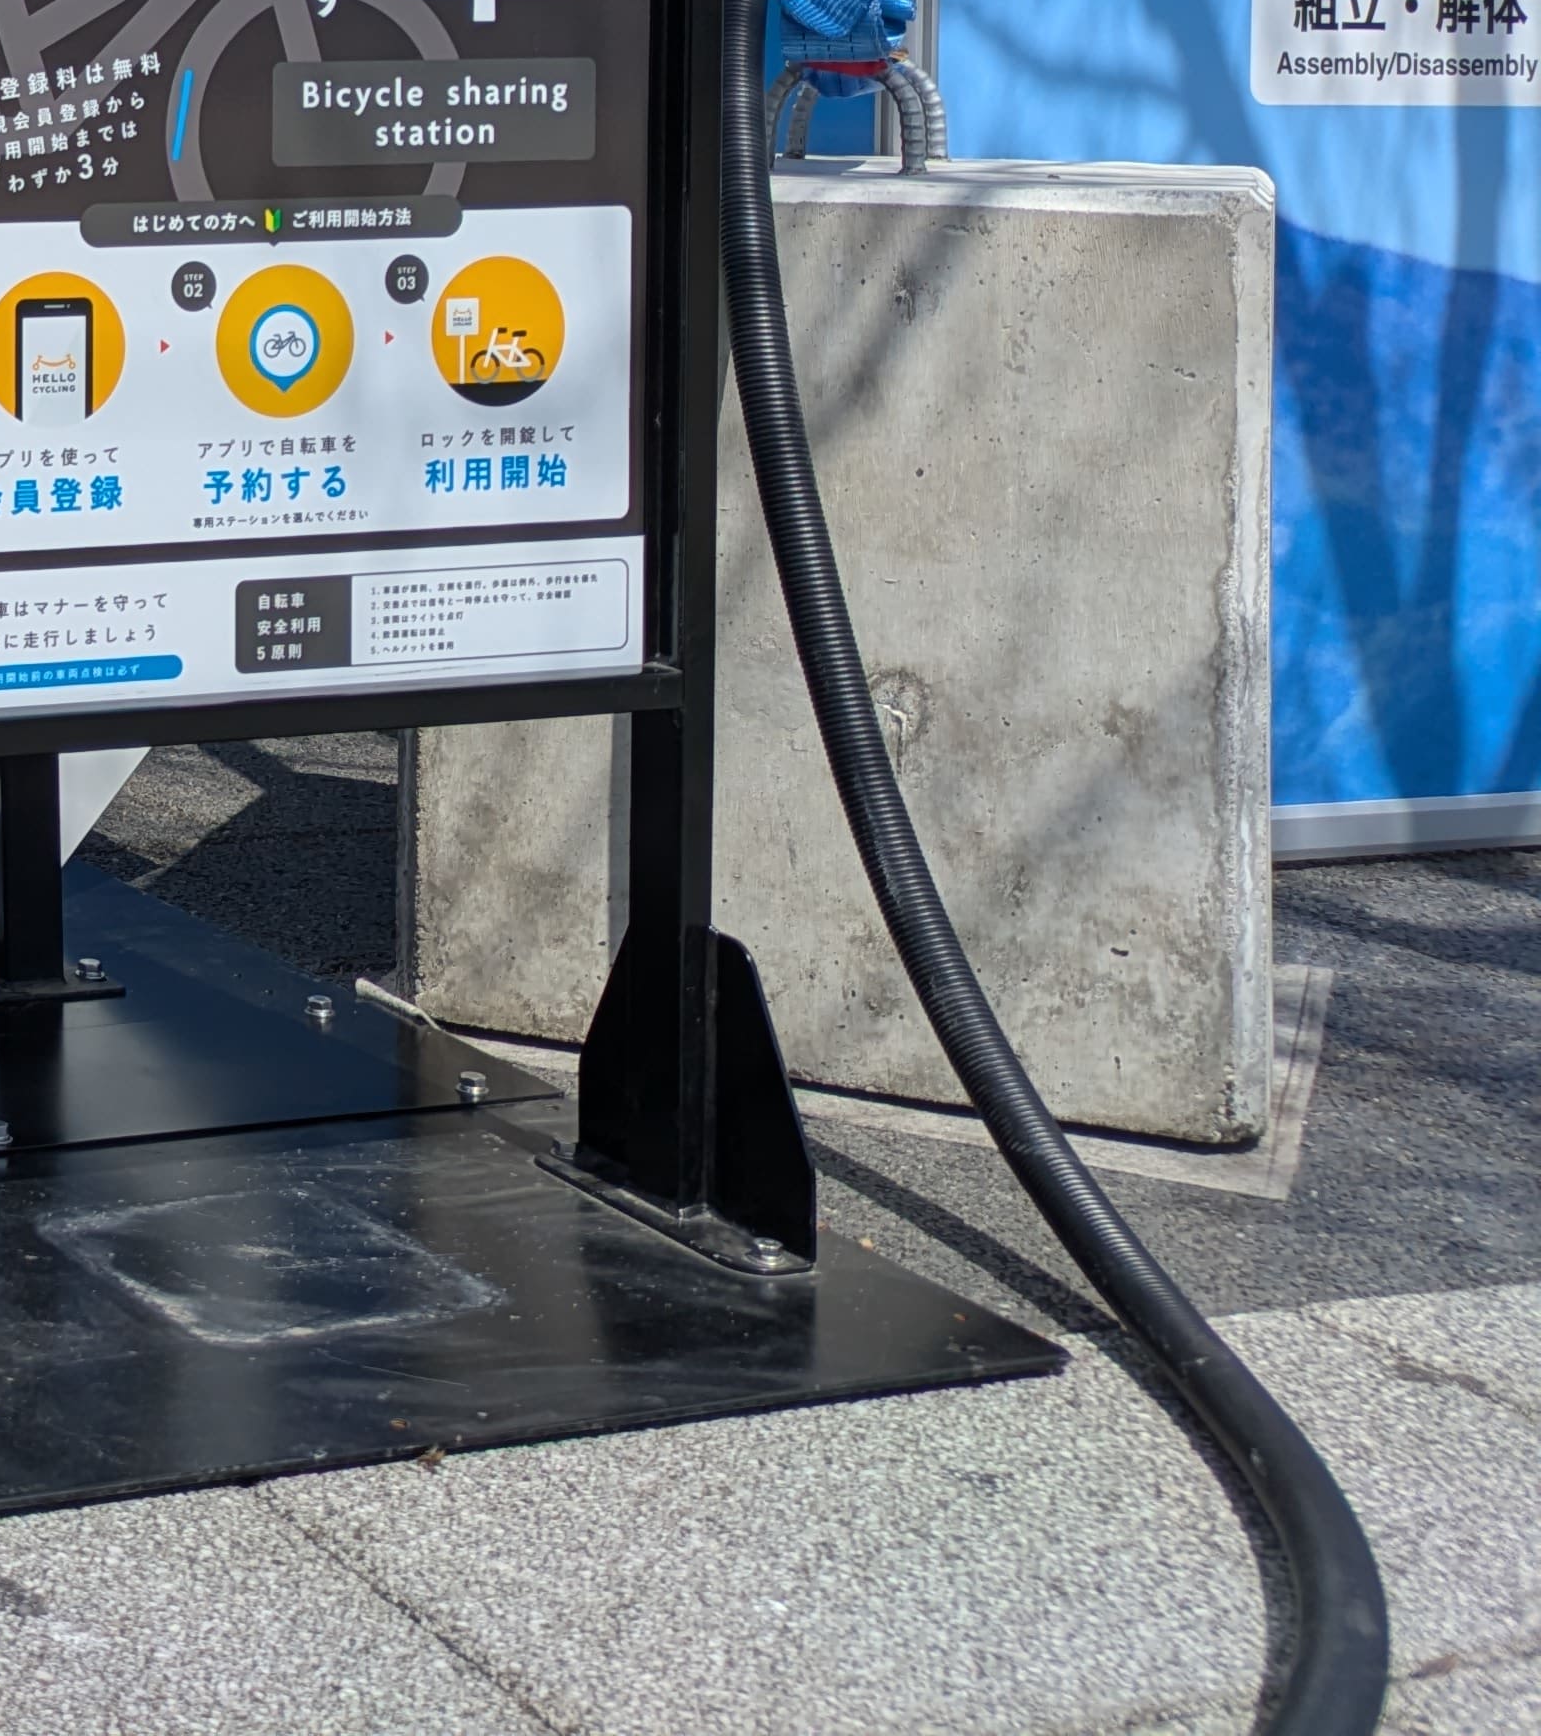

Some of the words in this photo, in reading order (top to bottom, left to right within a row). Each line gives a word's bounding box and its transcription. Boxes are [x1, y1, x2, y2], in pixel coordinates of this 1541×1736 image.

[1276, 50, 1539, 84] Assembly/Disassembly
[302, 76, 424, 116] Bicycle
[446, 75, 569, 113] sharing
[375, 117, 497, 148] station
[131, 209, 255, 233] はじめての方へ
[292, 207, 412, 230] ご利用開始方法
[182, 282, 204, 298] 02
[397, 276, 417, 291] 03
[32, 372, 76, 384] HELLO
[32, 384, 76, 394] CYCLING
[197, 434, 358, 459] アプリで自転車を
[420, 424, 575, 449] ロックを開錠して
[202, 465, 348, 505] 予約する
[424, 453, 568, 494] 利用開始
[192, 507, 369, 530] 専用ステーションを選んでください
[257, 592, 306, 611] 自転車
[256, 616, 322, 636] 安全利用
